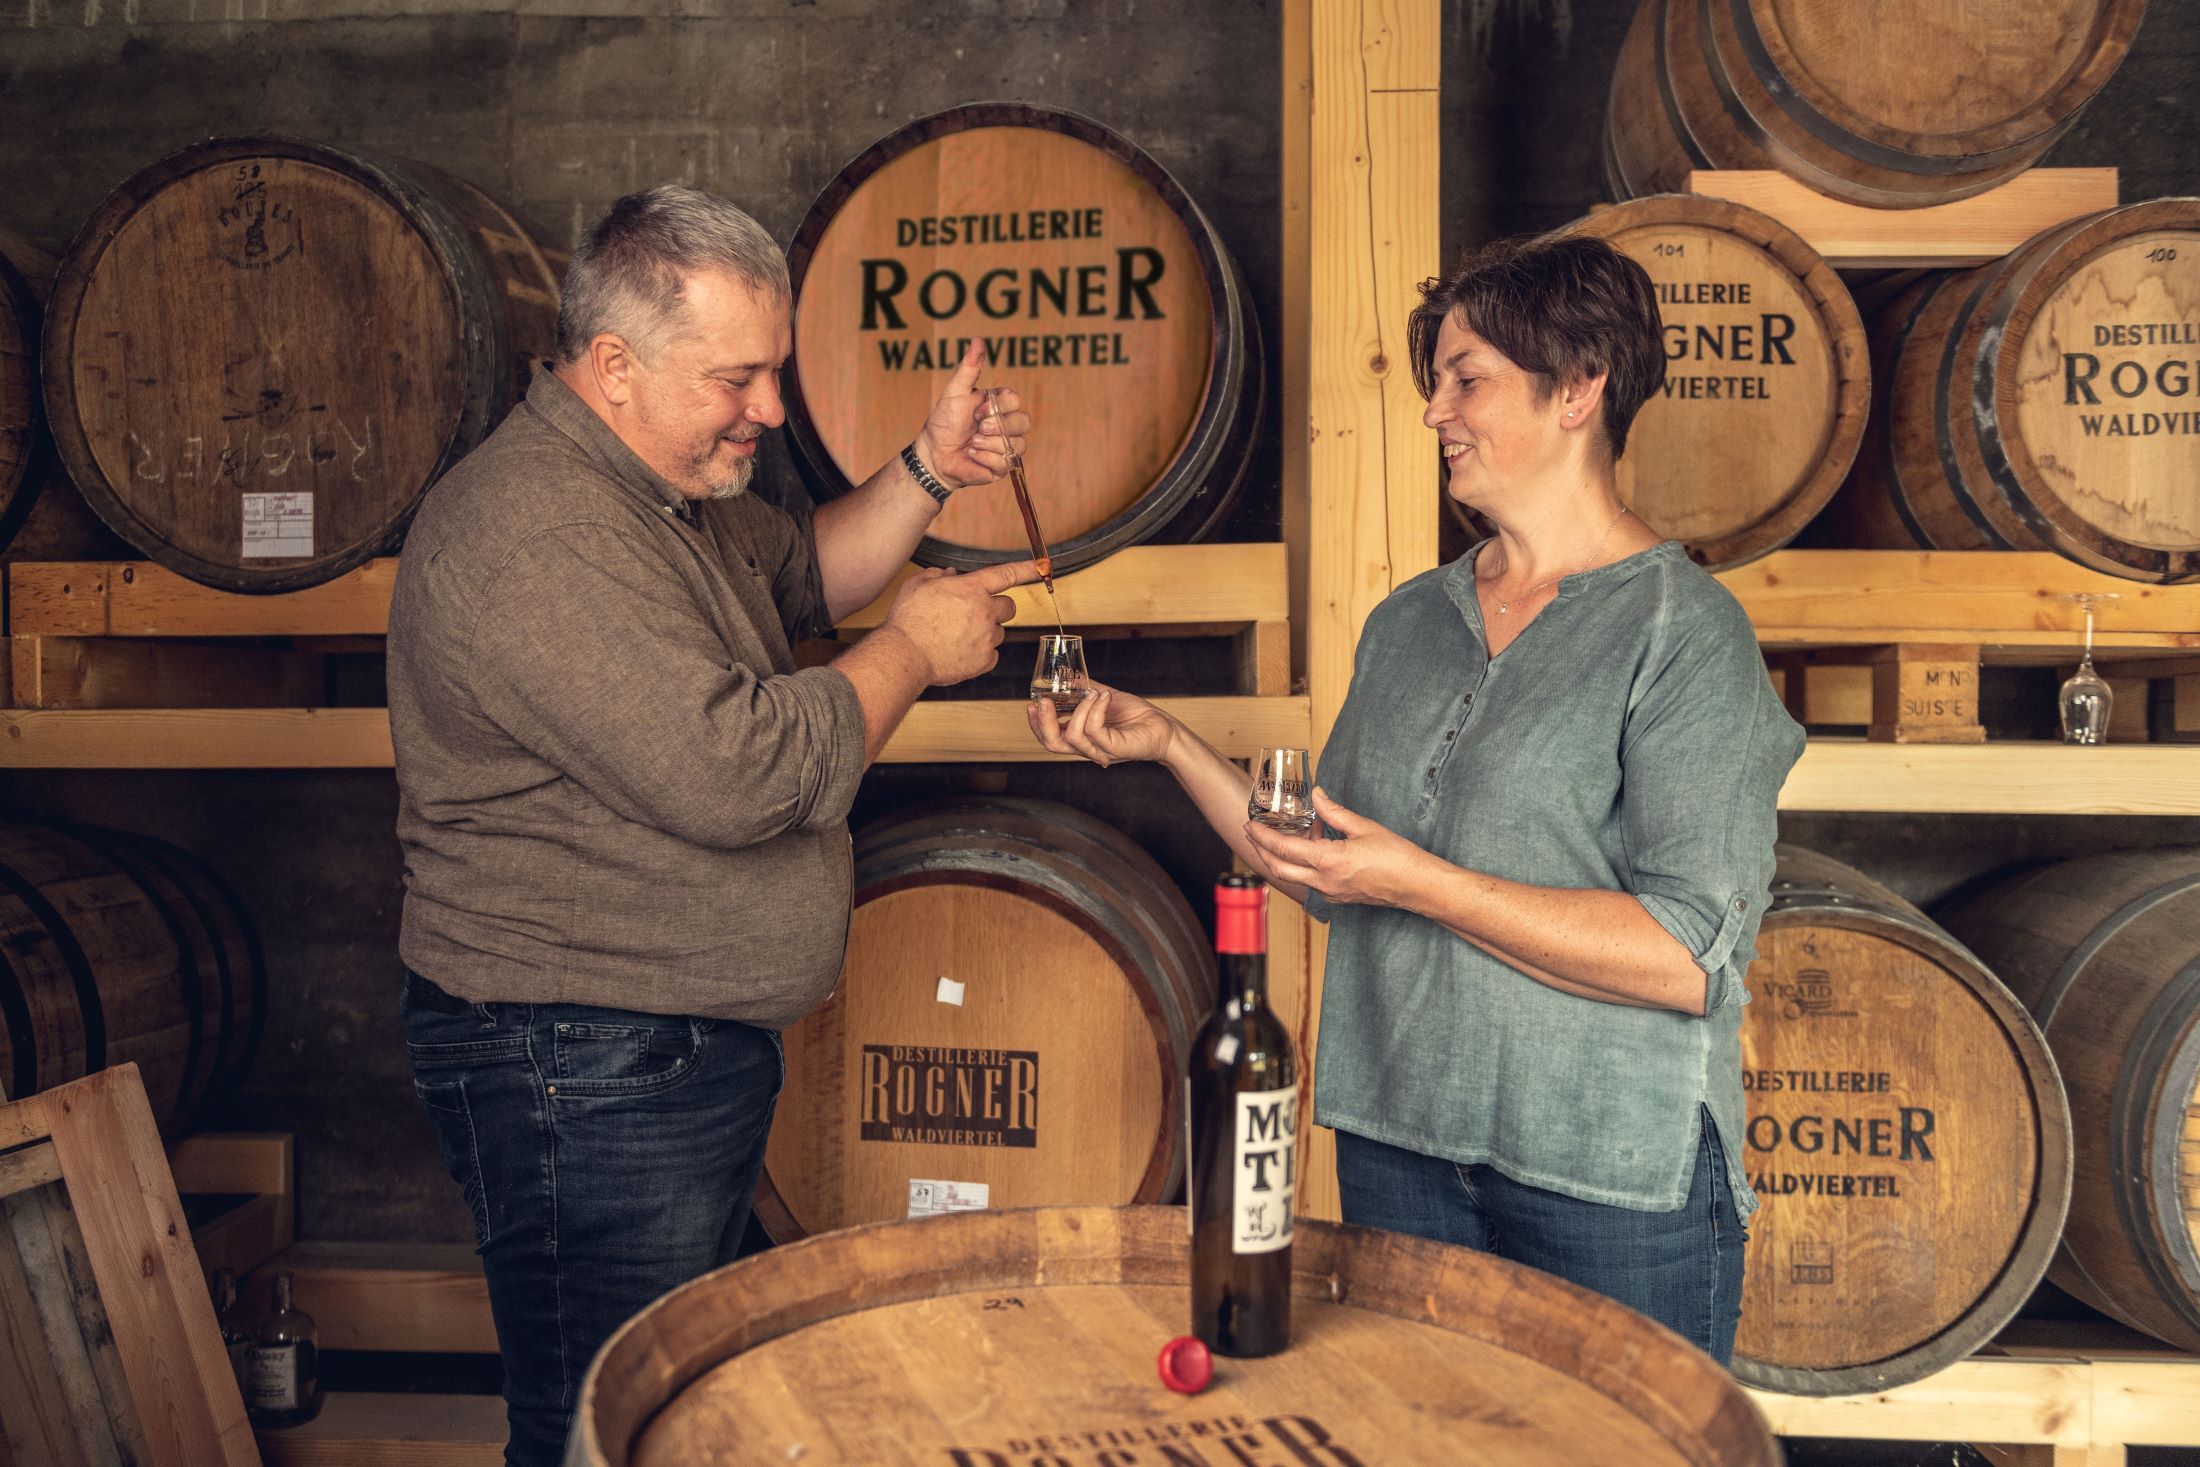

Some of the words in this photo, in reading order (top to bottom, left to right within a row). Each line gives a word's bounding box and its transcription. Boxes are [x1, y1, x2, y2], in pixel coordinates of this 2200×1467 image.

[896, 208, 1104, 248] DESTILLERIE
[1653, 243, 1685, 258] 101
[2145, 248, 2177, 263] 100
[859, 247, 1167, 331] ROGNER
[1653, 283, 1752, 304] ILLERIE
[1663, 313, 1797, 365] GNER
[2094, 323, 2200, 346] DESTILL
[1663, 377, 1771, 400] VIERTEL
[2062, 352, 2200, 405] ROG
[1905, 700, 1963, 716] SUISE
[892, 1046, 1008, 1067] DESTILLERIE
[862, 1051, 1036, 1130] ROGNER
[1741, 1071, 1890, 1093] DESTILLERIE
[892, 1126, 1006, 1147] WALDVIERTEL
[1747, 1107, 1936, 1162] OGNER
[1007, 1415, 1249, 1457] DESTILLERIE
